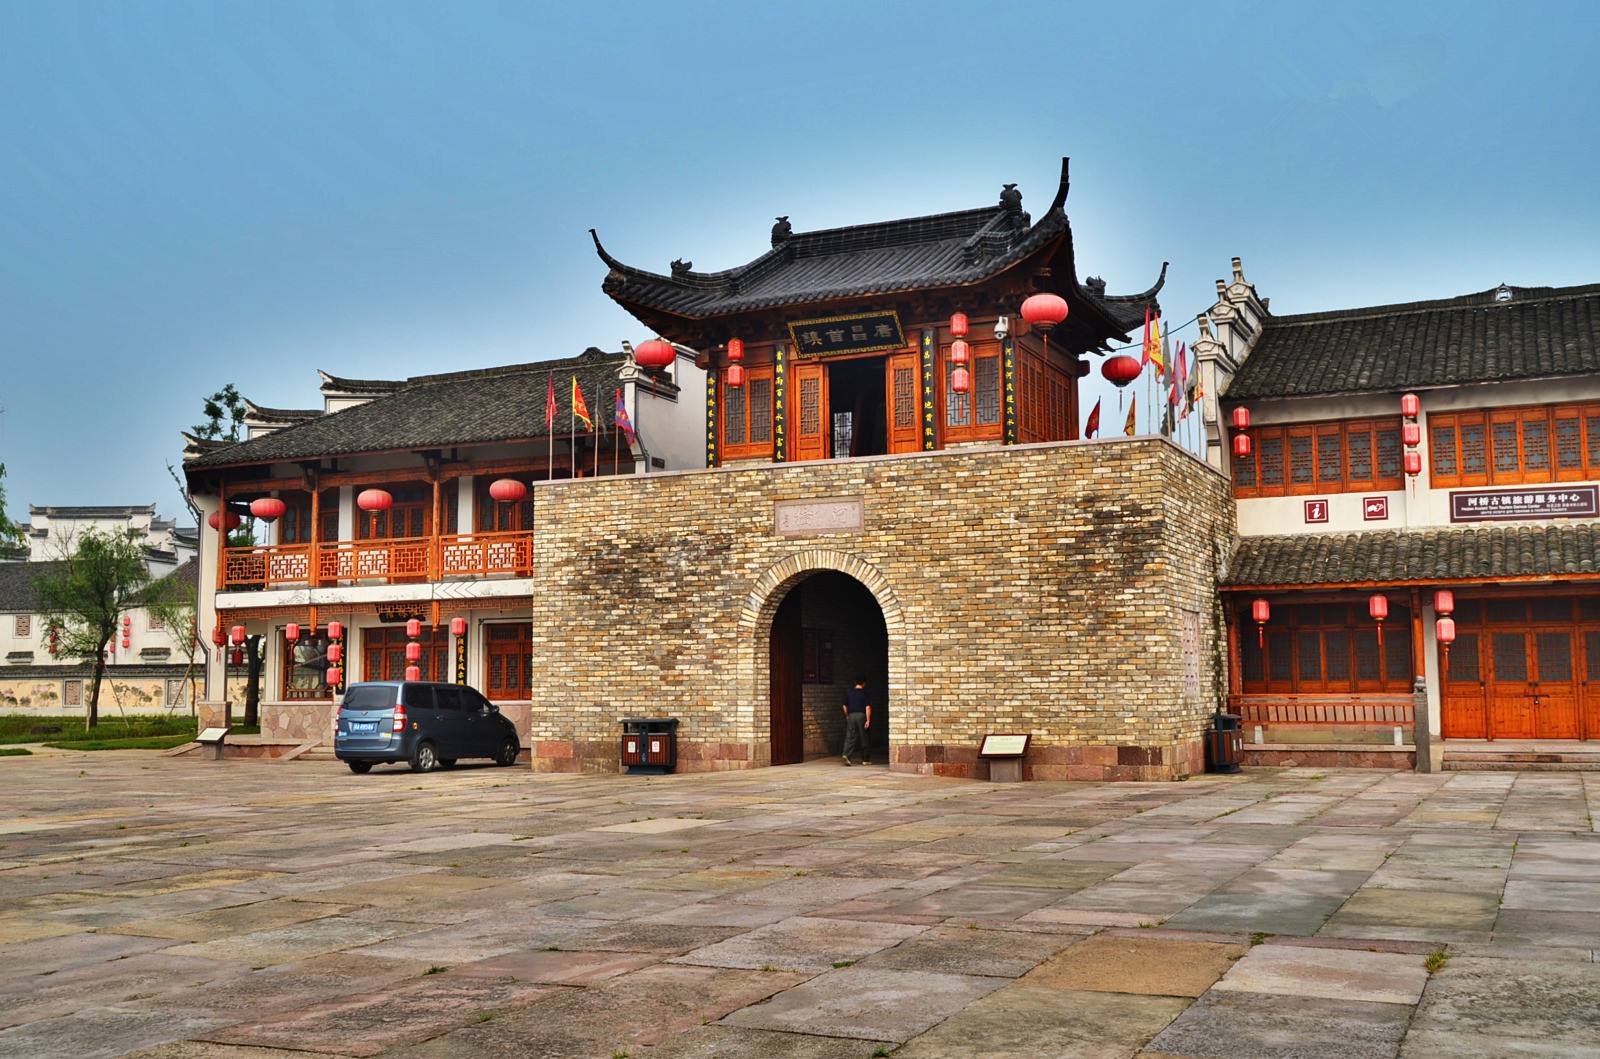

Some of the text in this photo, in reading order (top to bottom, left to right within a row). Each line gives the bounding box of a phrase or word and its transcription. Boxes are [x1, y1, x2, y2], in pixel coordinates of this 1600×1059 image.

[1468, 493, 1580, 506] 河桥古镇旅游服务中心
